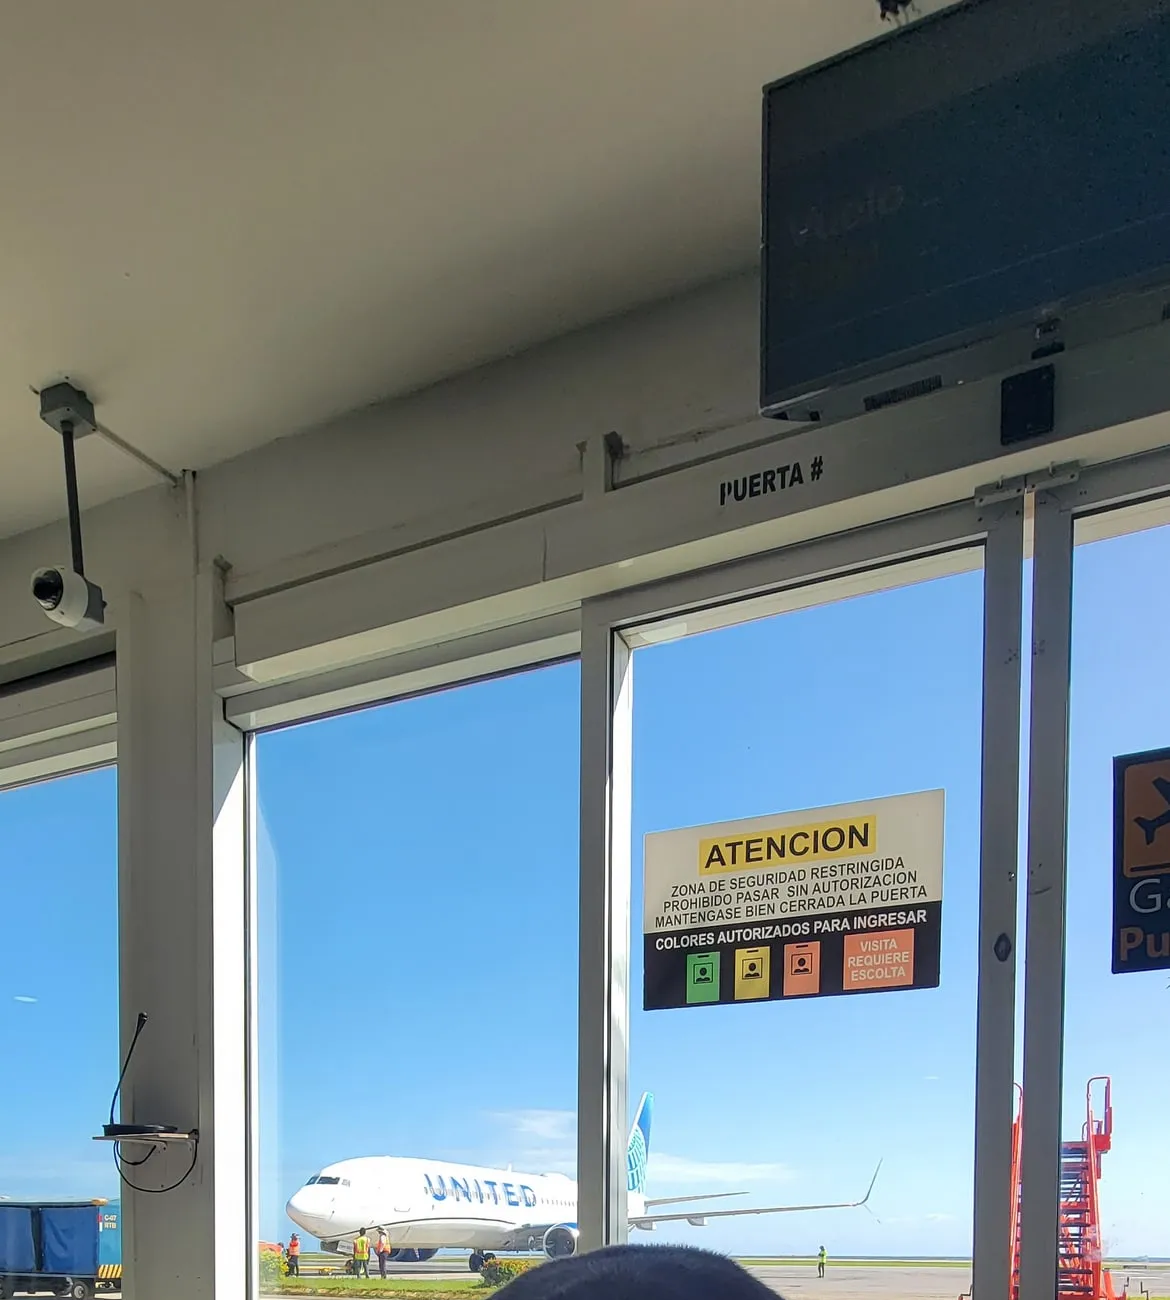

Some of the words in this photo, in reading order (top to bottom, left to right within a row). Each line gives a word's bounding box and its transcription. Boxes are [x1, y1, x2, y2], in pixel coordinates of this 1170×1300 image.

[719, 462, 804, 506] PUERTA
[810, 455, 824, 482] #
[704, 822, 869, 869] ATENCION
[663, 893, 732, 913] PROHIBIDO
[736, 887, 780, 904] PASAR
[787, 883, 809, 898] SIN
[812, 870, 918, 895] AUTORIZACION
[671, 882, 706, 898] ZONA
[709, 879, 727, 893] DE
[729, 869, 807, 890] SEGURIDAD
[810, 856, 905, 880] RESTRINGIDA
[1129, 878, 1170, 914] G
[655, 906, 742, 928] MANTENGASE
[745, 902, 776, 918] BIEN
[780, 896, 846, 913] CERRADA
[849, 892, 867, 906] LA
[871, 885, 928, 903] PUERTA
[655, 932, 715, 950] COLORES
[717, 921, 810, 944] AUTORIZADOS
[813, 917, 851, 934] PARA
[853, 909, 928, 930] INGRESAR
[860, 938, 898, 953] VISITA
[847, 951, 910, 968] REQUIERE
[851, 966, 906, 982] ESCOLTA
[424, 1173, 538, 1208] UNITED
